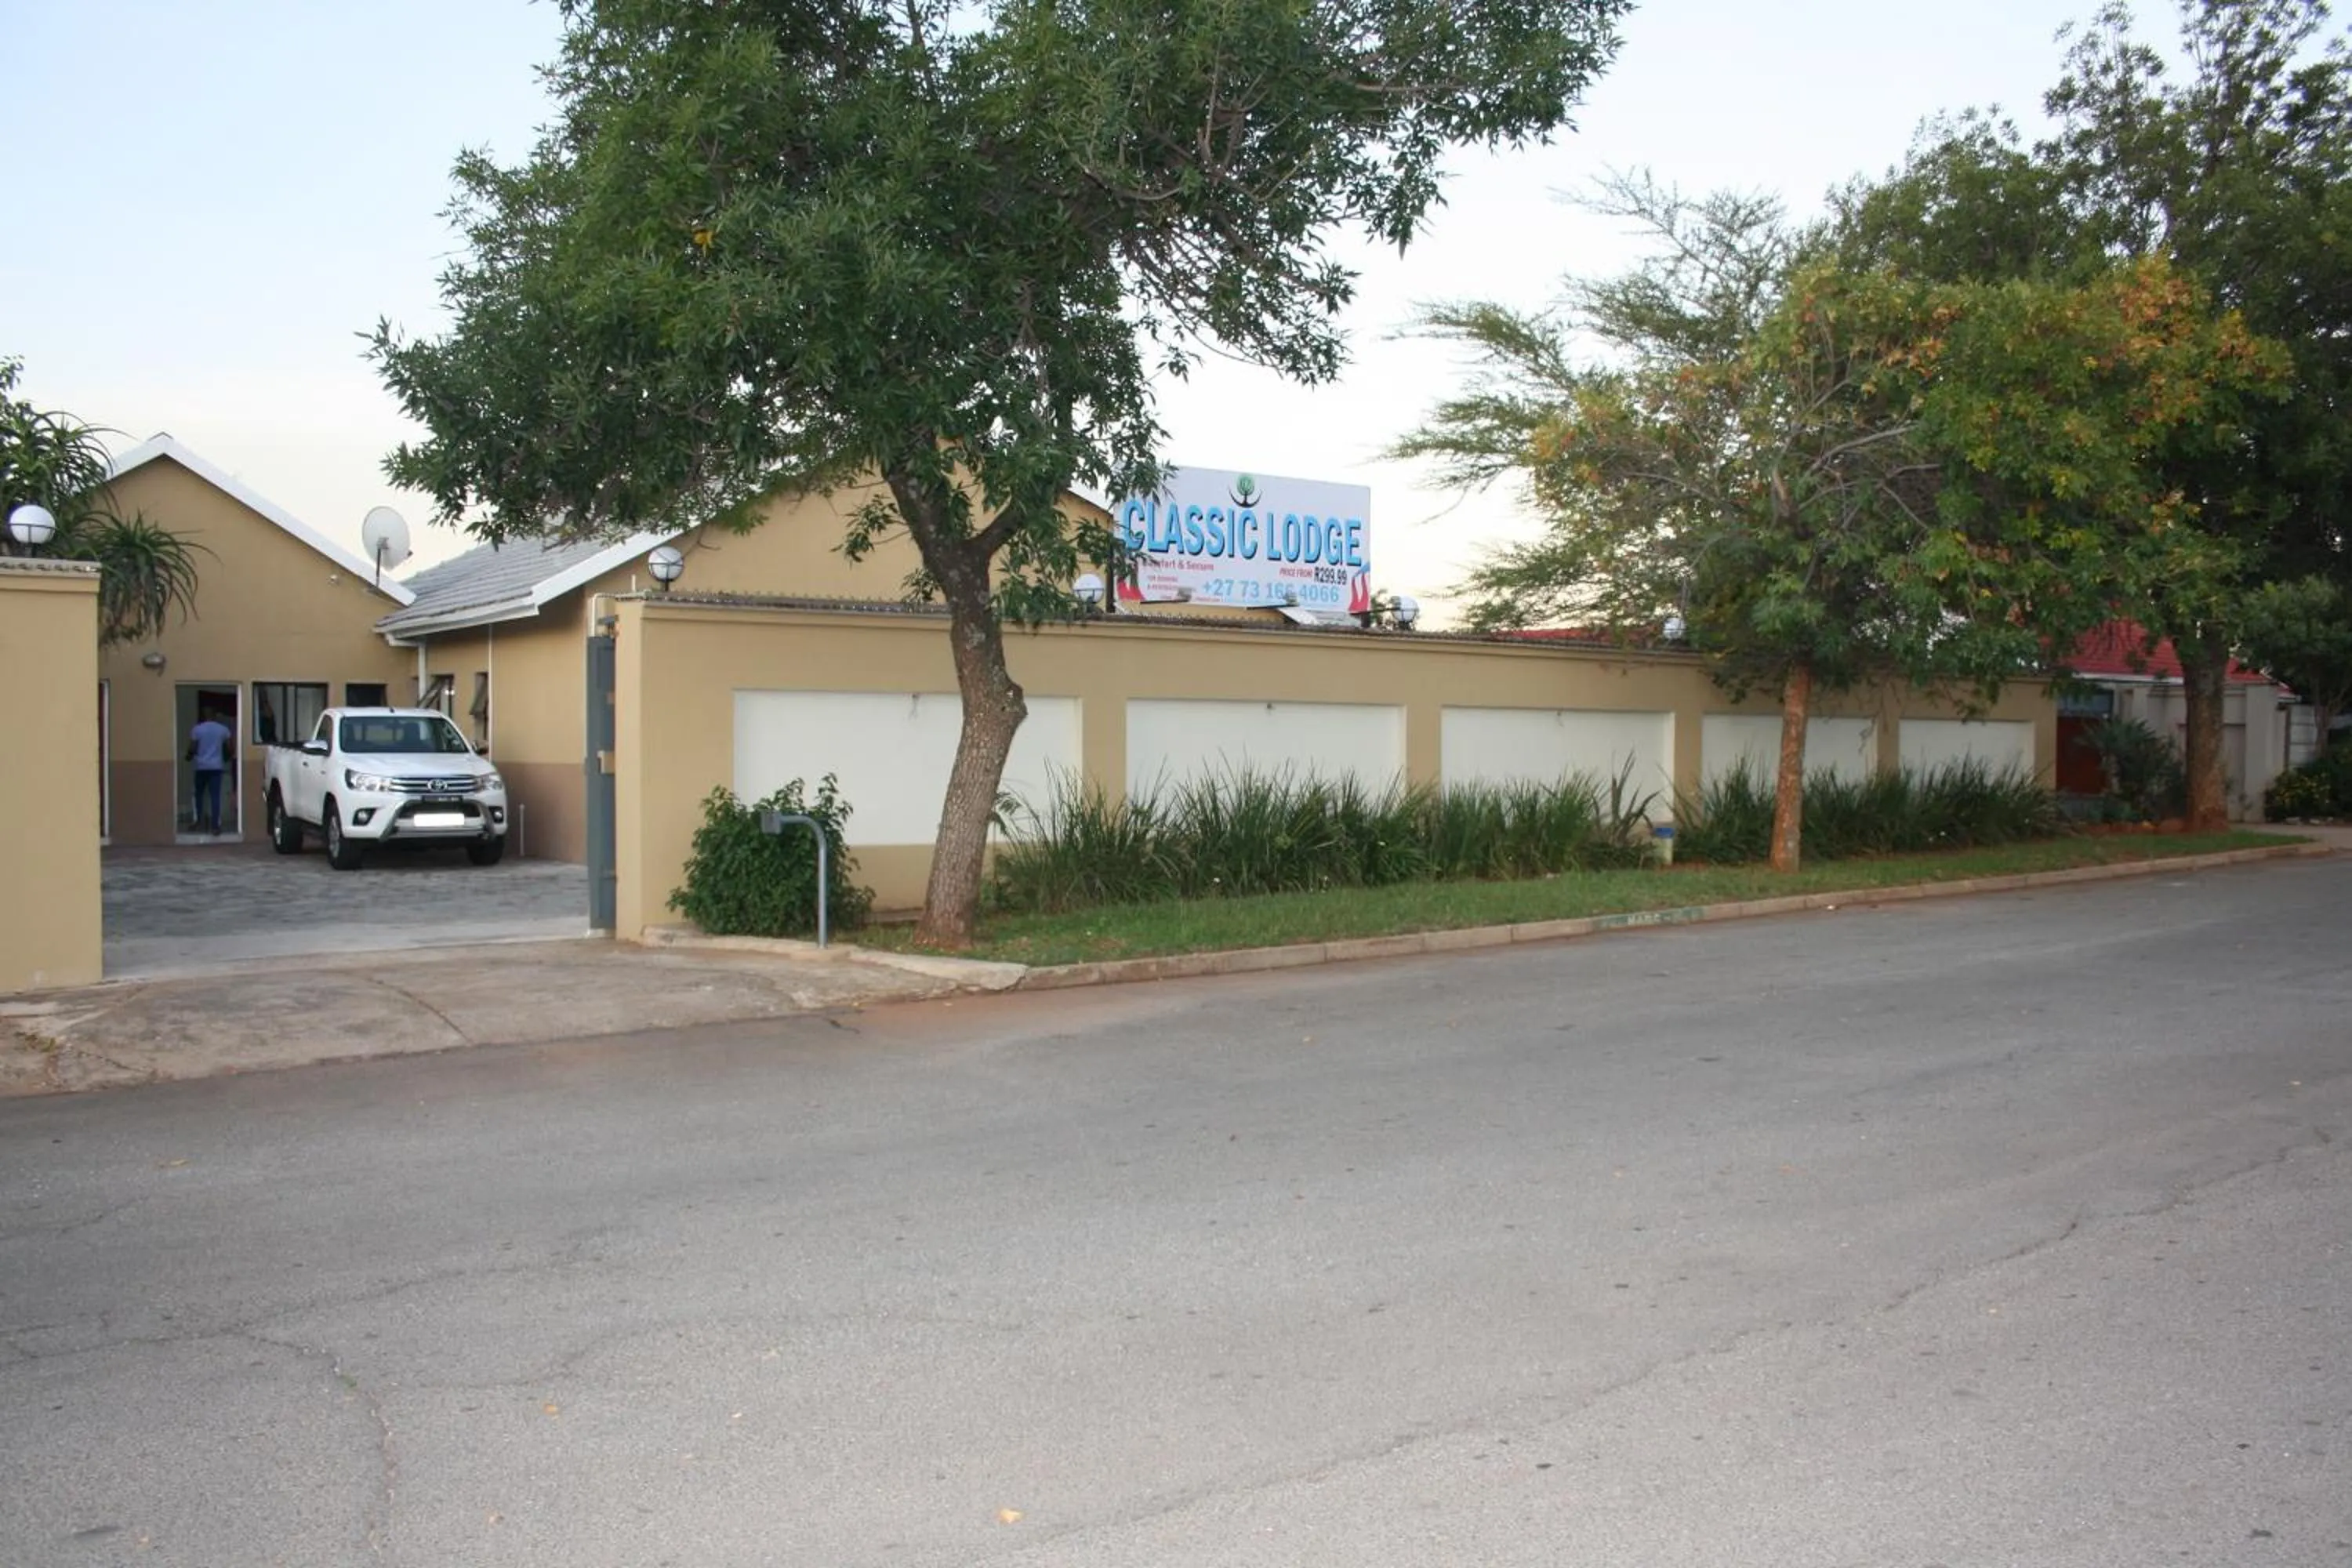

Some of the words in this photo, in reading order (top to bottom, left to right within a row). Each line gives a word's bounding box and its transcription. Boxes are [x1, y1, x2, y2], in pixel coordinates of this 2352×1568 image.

[1122, 499, 1258, 561] CLASSIC
[1266, 512, 1362, 567] LODGE
[1279, 567, 1296, 577] PRICE
[1296, 568, 1313, 578] FROM
[1314, 566, 1348, 585] R299.99
[1203, 578, 1235, 597] +27
[1240, 579, 1260, 598] 73
[1299, 583, 1340, 603] 4066
